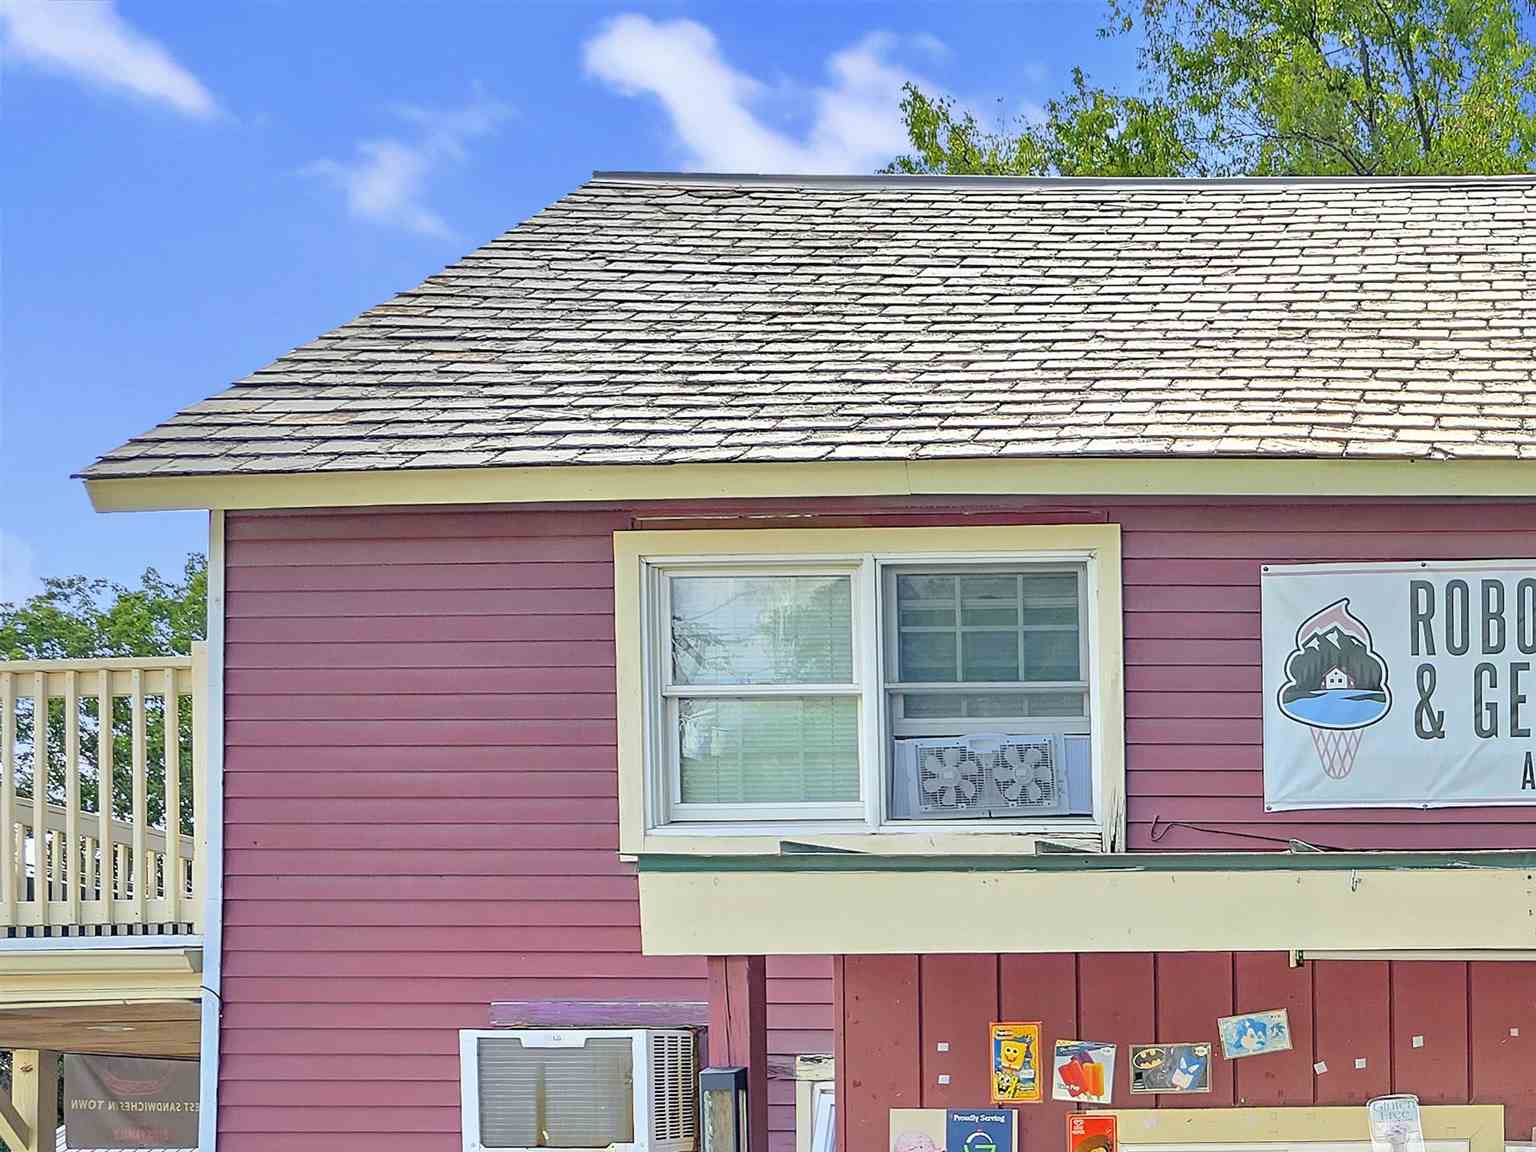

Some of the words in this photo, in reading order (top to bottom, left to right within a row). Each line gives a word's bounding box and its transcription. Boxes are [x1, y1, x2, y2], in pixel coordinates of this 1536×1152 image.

[1415, 662, 1446, 739] &
[953, 1113, 979, 1123] Proudly
[980, 1114, 1006, 1123] Serving
